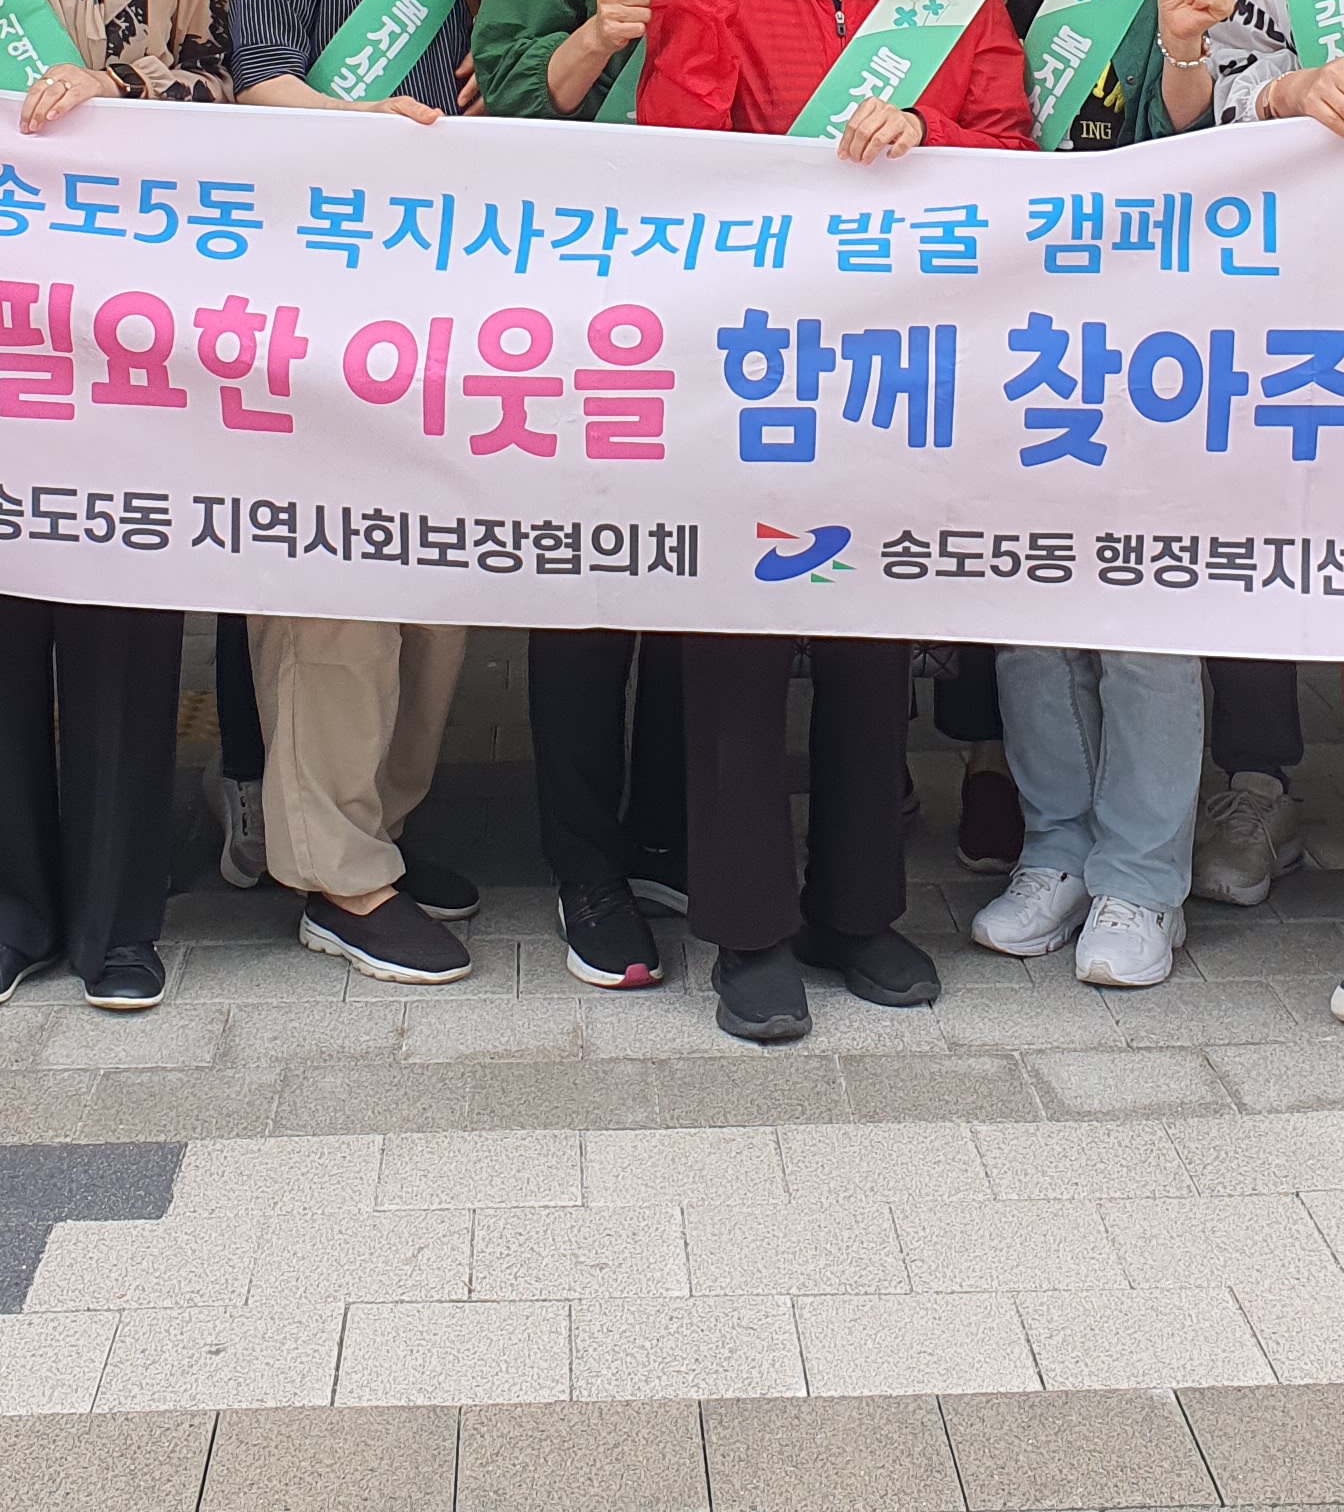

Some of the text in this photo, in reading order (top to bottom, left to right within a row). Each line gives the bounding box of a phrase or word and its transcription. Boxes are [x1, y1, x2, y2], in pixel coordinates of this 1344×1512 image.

[1029, 25, 1093, 138] 복지사
[1080, 120, 1113, 140] ING
[297, 186, 793, 278] 복지사각지대
[827, 204, 989, 275] 발굴
[1027, 191, 1280, 277] 캠페인
[343, 304, 675, 460] 이웃을
[717, 308, 957, 463] 함께
[191, 494, 698, 577] 지역사회보장협의체
[880, 529, 1076, 584] 송도5동
